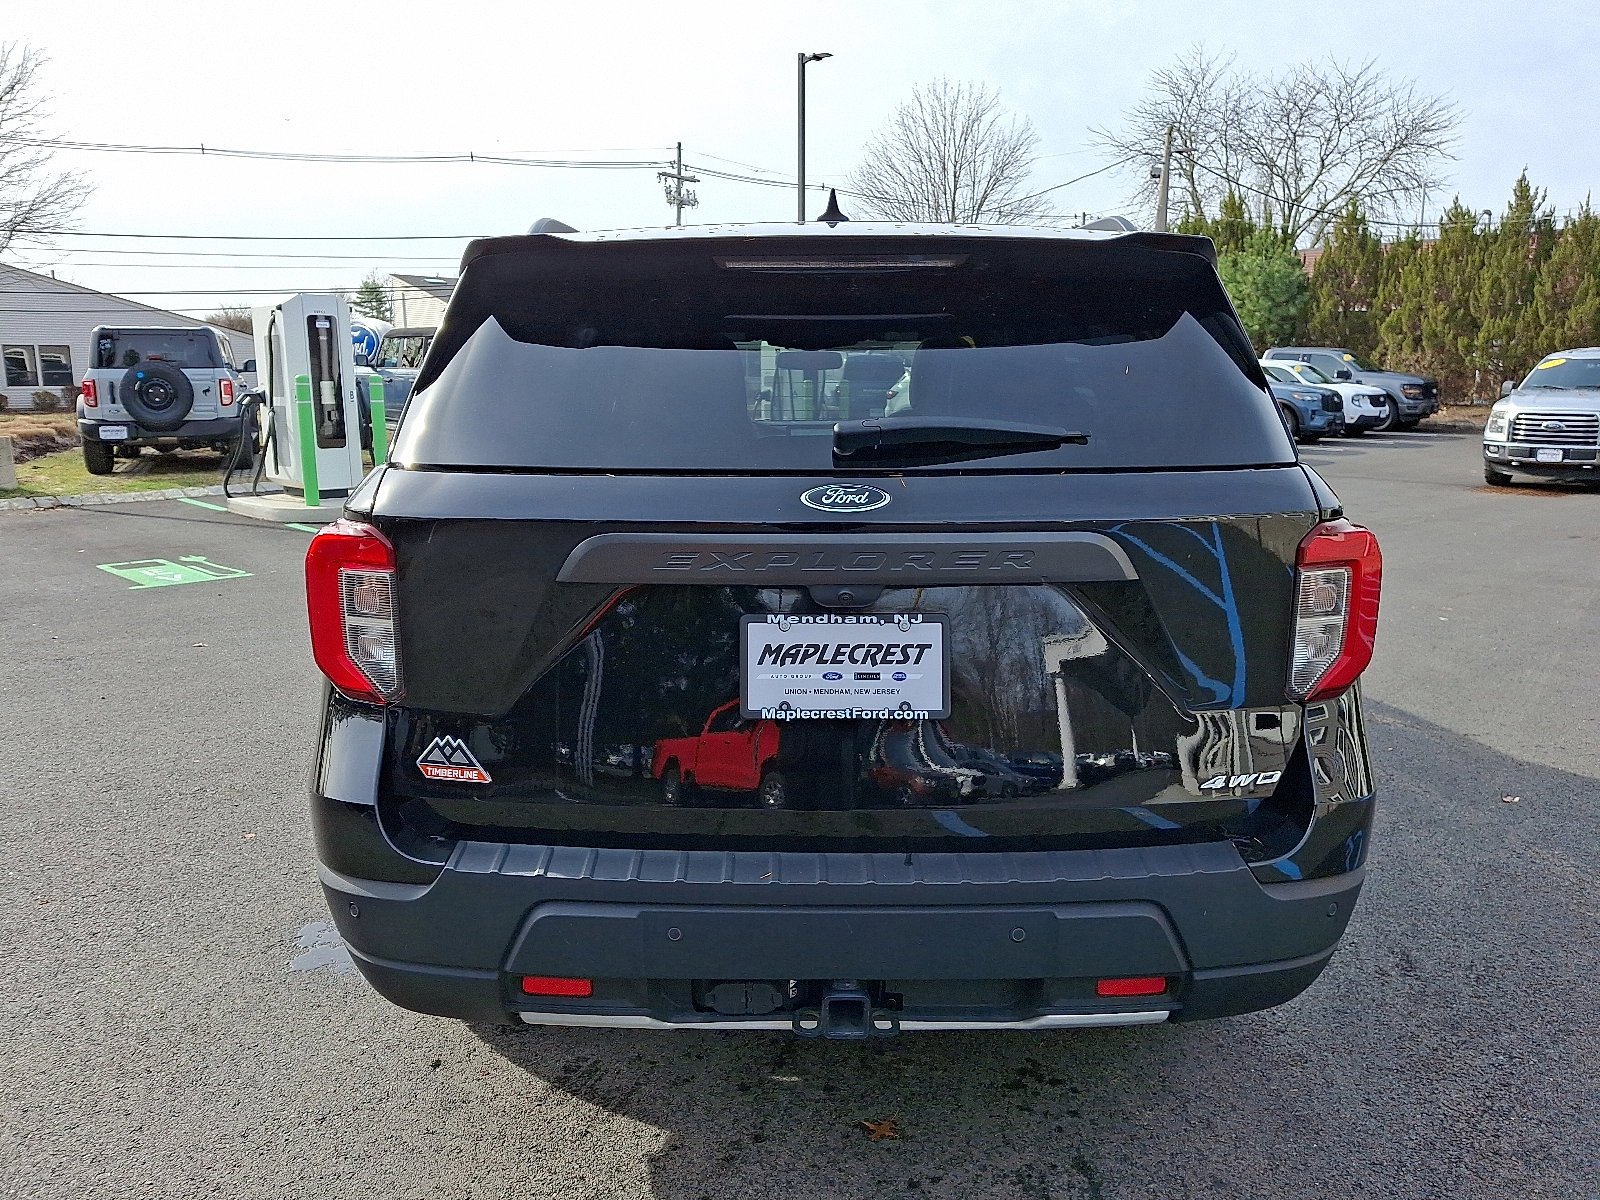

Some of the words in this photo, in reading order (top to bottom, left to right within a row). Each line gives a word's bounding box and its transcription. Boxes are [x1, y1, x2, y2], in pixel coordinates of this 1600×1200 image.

[821, 487, 869, 504] Ford
[652, 550, 1036, 571] EXPLORER
[766, 613, 885, 626] Mendham,
[894, 613, 924, 625] NJ
[756, 643, 933, 667] MAPLECREST
[813, 688, 852, 697] MENDHAM,
[761, 707, 929, 720] MaplecrestFord.com
[426, 767, 479, 779] TIMBERLINE
[1200, 771, 1282, 789] 4WD
